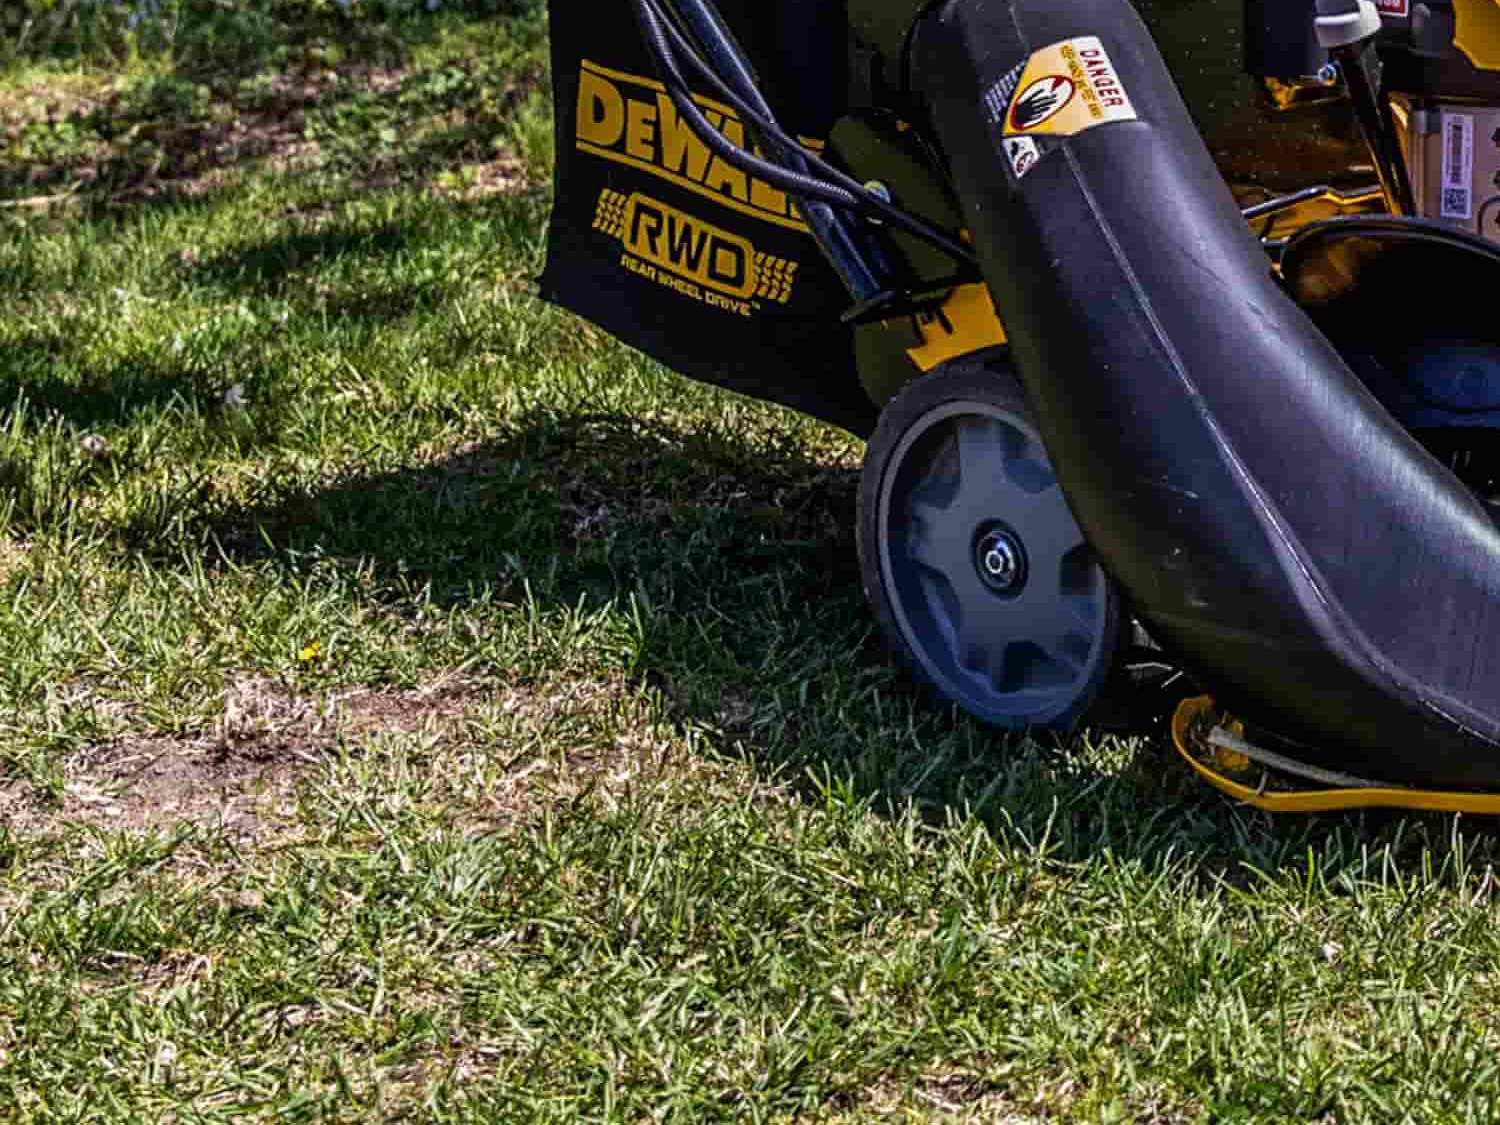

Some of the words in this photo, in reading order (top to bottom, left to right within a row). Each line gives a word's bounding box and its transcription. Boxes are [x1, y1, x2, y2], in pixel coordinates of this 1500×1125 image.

[1079, 47, 1124, 108] DANGER
[630, 203, 746, 288] RWD
[620, 253, 657, 281] REAR
[657, 269, 703, 301] WHEEL
